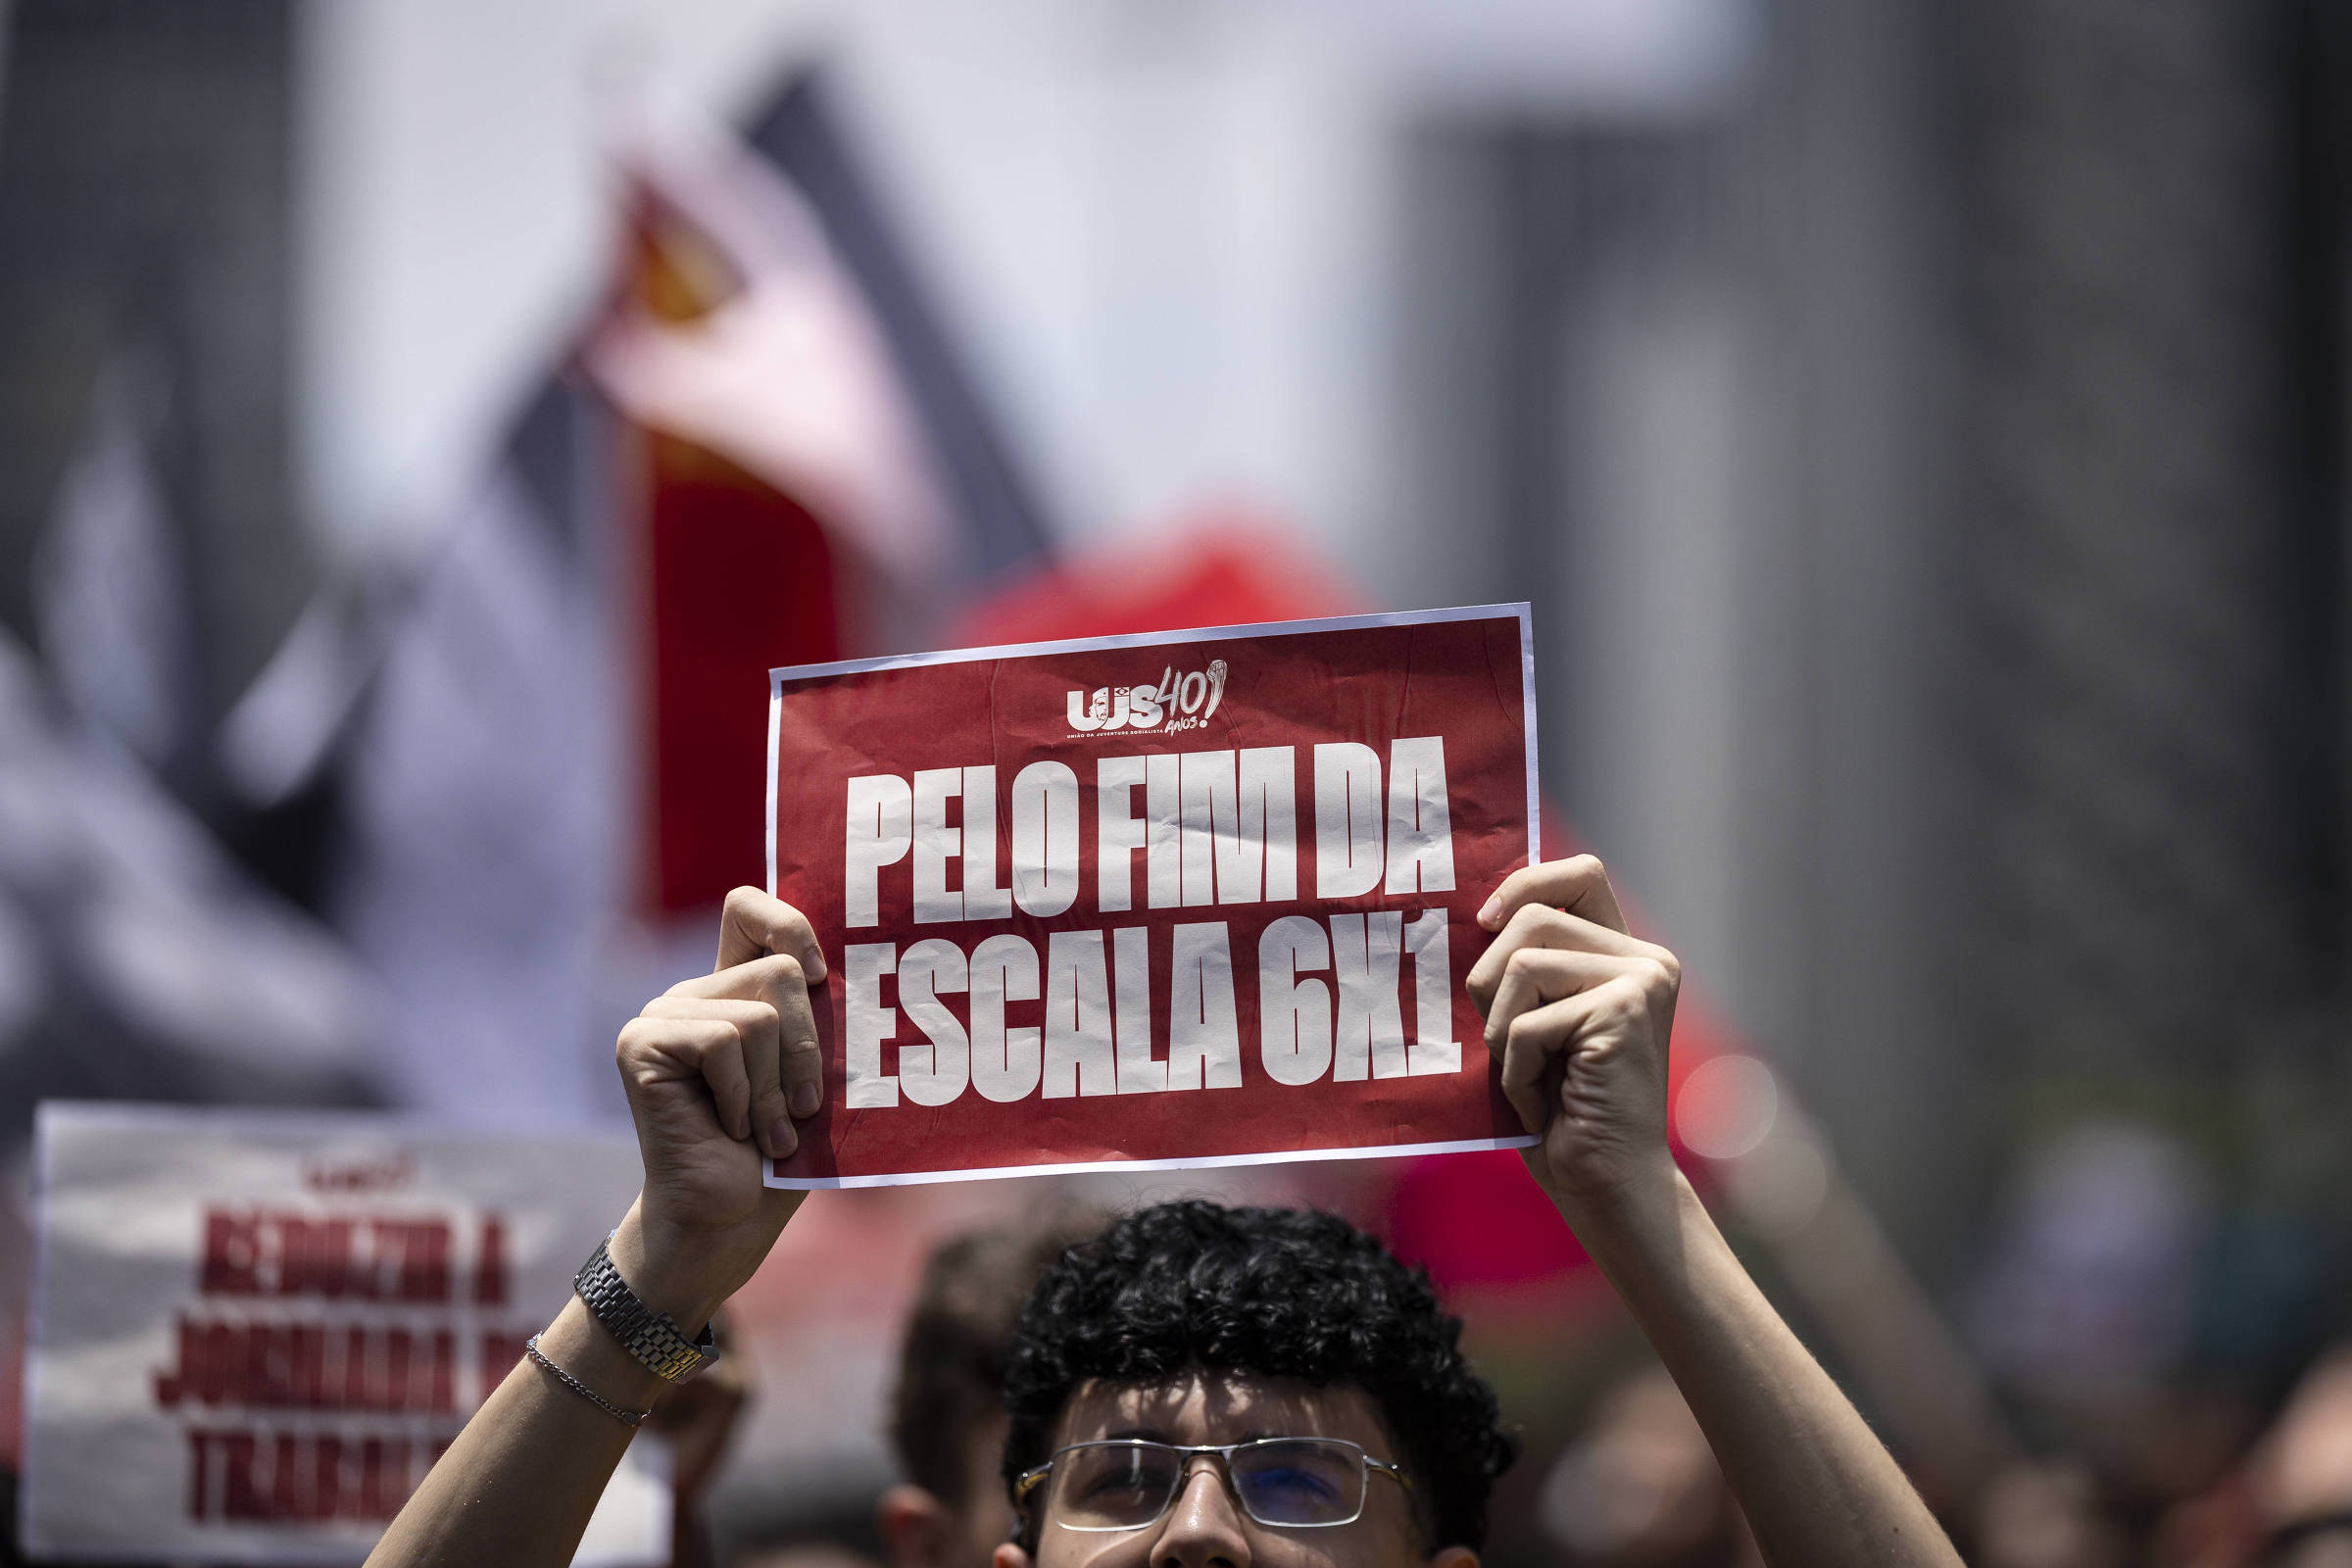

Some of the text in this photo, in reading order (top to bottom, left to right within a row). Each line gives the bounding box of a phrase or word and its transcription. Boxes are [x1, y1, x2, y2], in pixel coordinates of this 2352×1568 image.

[1066, 685, 1163, 732] UJS
[845, 735, 1456, 928] PELO FIM DA
[844, 907, 1462, 1109] ESCALA 6X1
